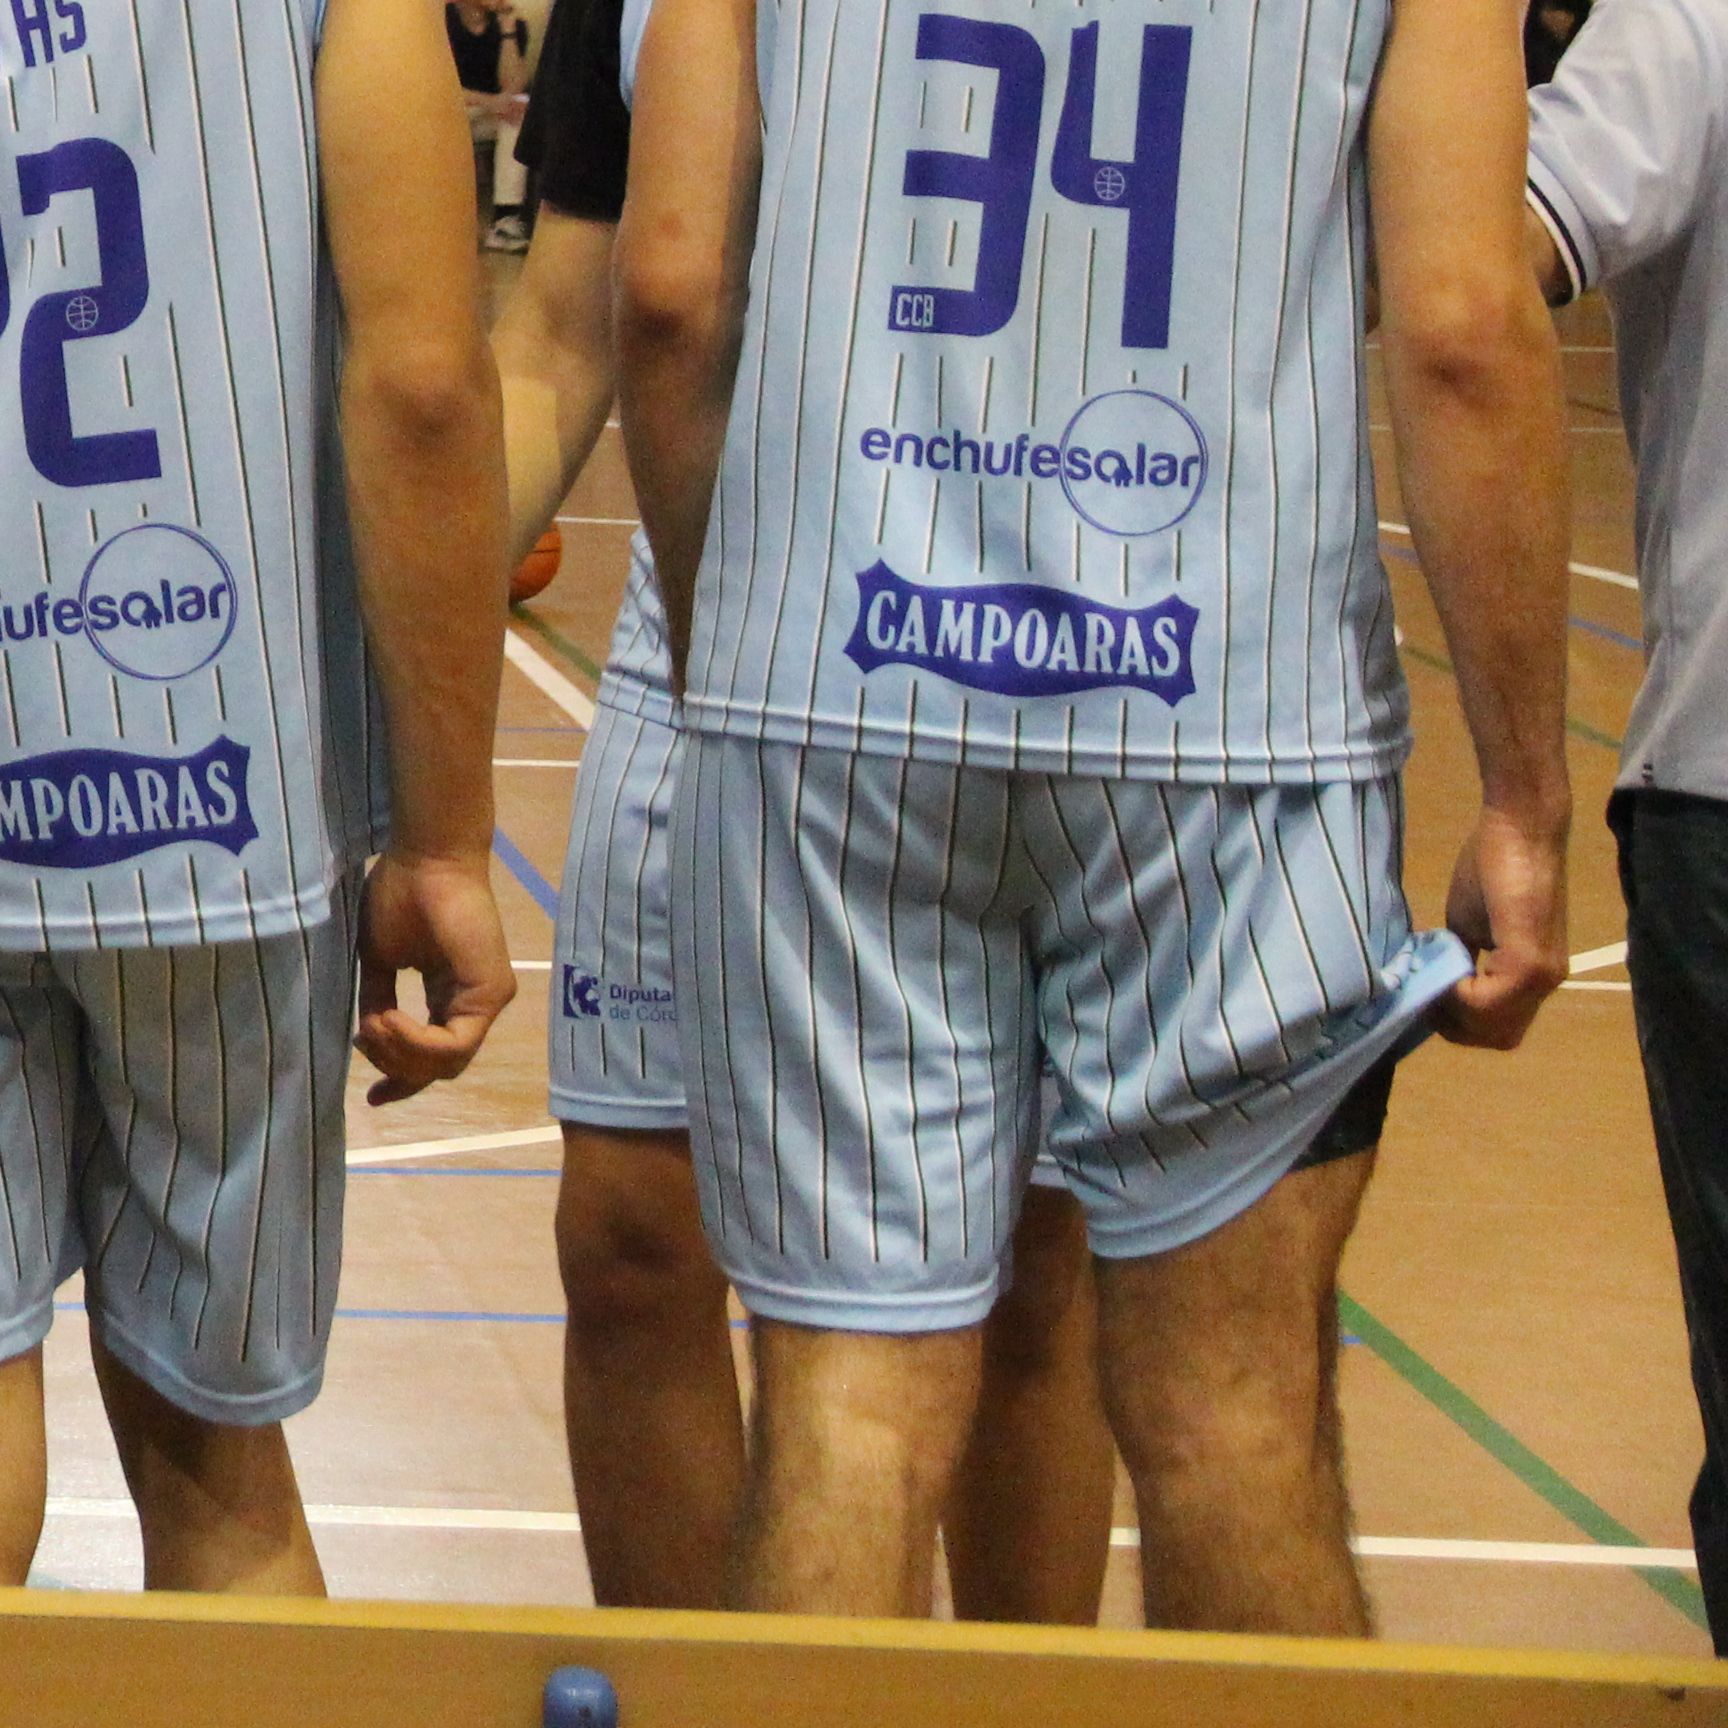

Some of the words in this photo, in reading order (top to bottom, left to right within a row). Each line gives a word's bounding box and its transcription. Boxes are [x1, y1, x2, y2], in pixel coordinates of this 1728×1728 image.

[888, 13, 1193, 349] 34
[896, 293, 935, 329] CCB
[860, 428, 1198, 487] enchufesolar
[866, 590, 1181, 678] CAMPOARAS
